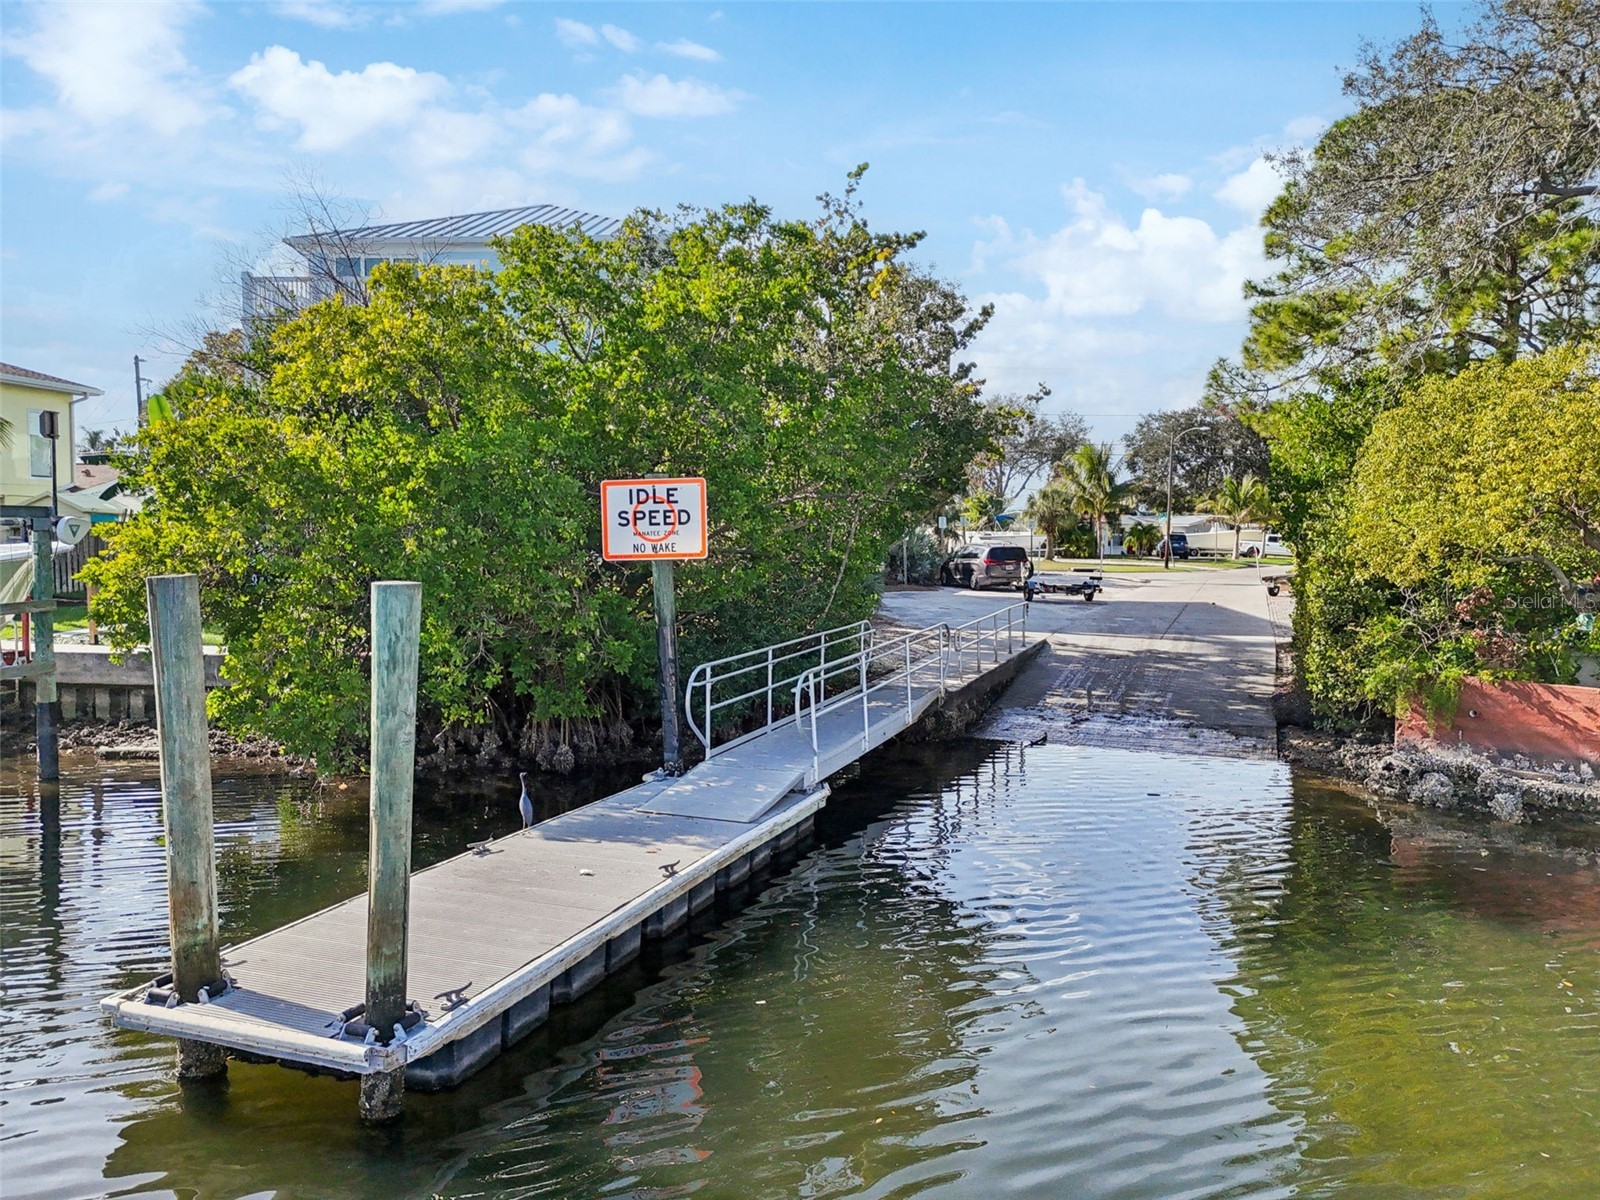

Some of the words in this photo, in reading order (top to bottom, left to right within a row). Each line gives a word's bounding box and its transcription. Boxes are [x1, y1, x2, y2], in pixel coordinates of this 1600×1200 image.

[629, 488, 678, 505] IDLE
[618, 509, 691, 527] SPEED
[633, 543, 646, 553] NO
[651, 542, 677, 553] WAKE
